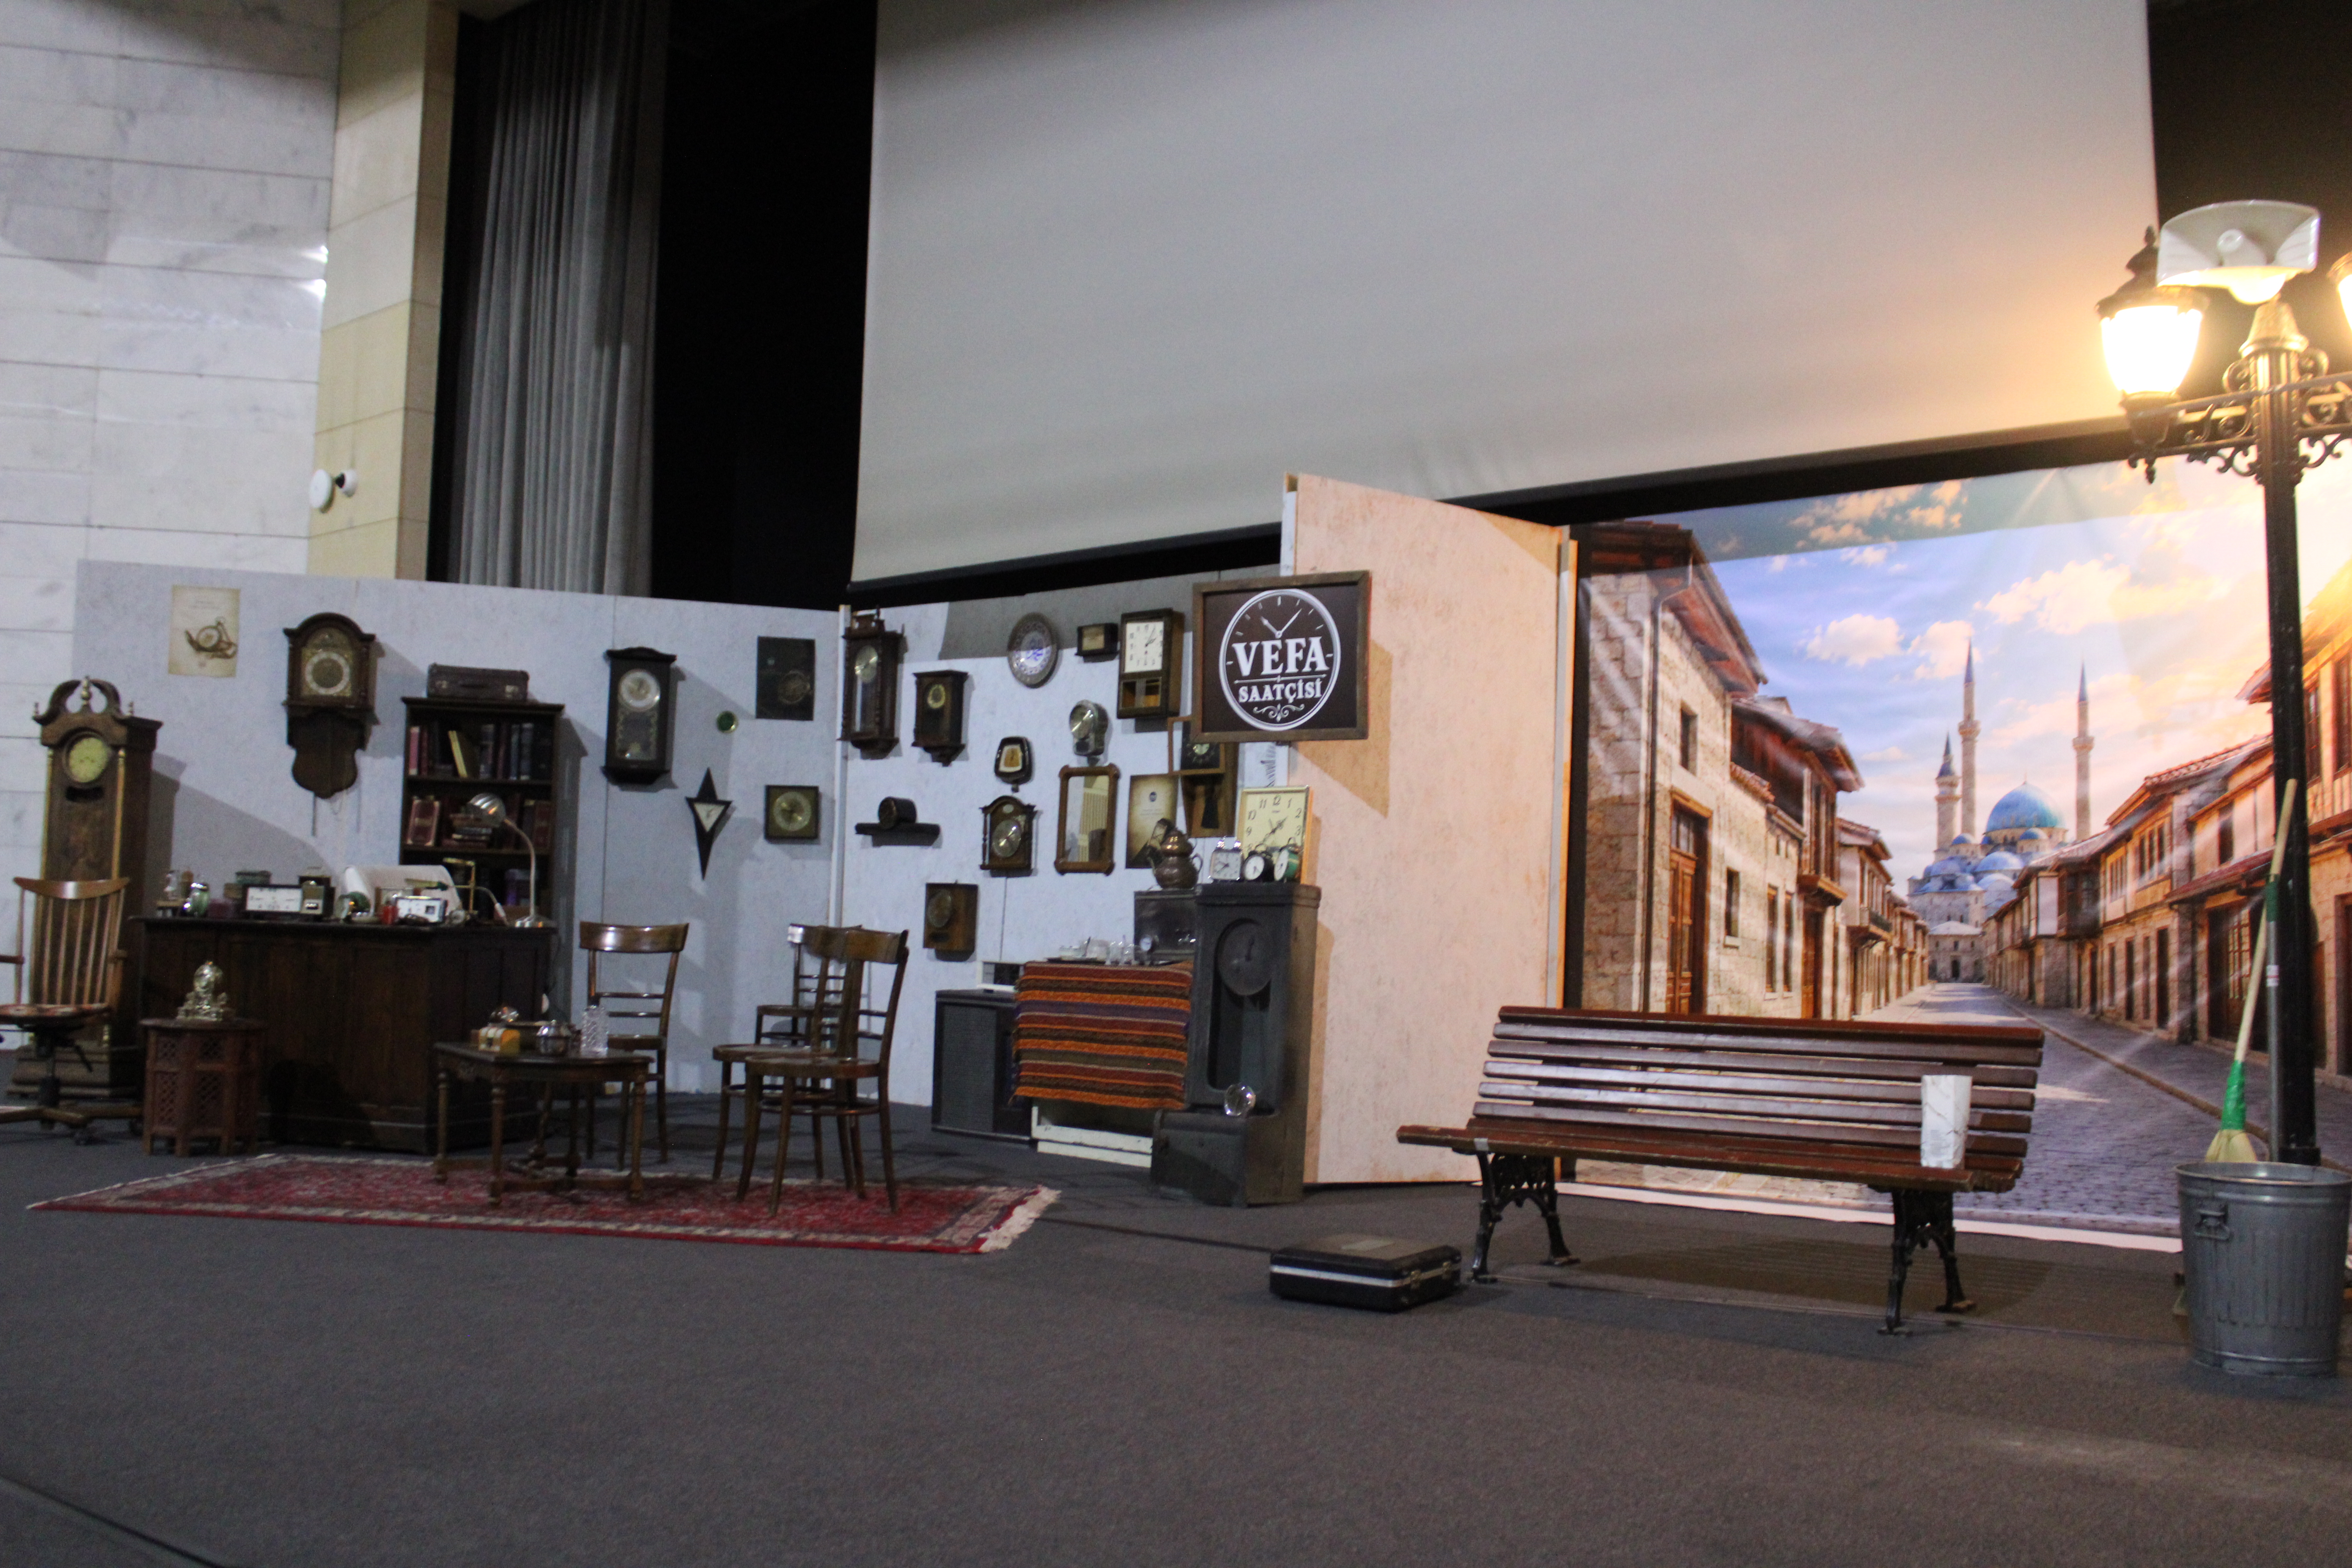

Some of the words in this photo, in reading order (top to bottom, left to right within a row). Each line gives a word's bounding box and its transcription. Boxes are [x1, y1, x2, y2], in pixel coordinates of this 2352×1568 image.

[1232, 636, 1329, 676] VEFA
[1238, 678, 1323, 703] SAATÇİSİ
[1295, 808, 1302, 818] 2
